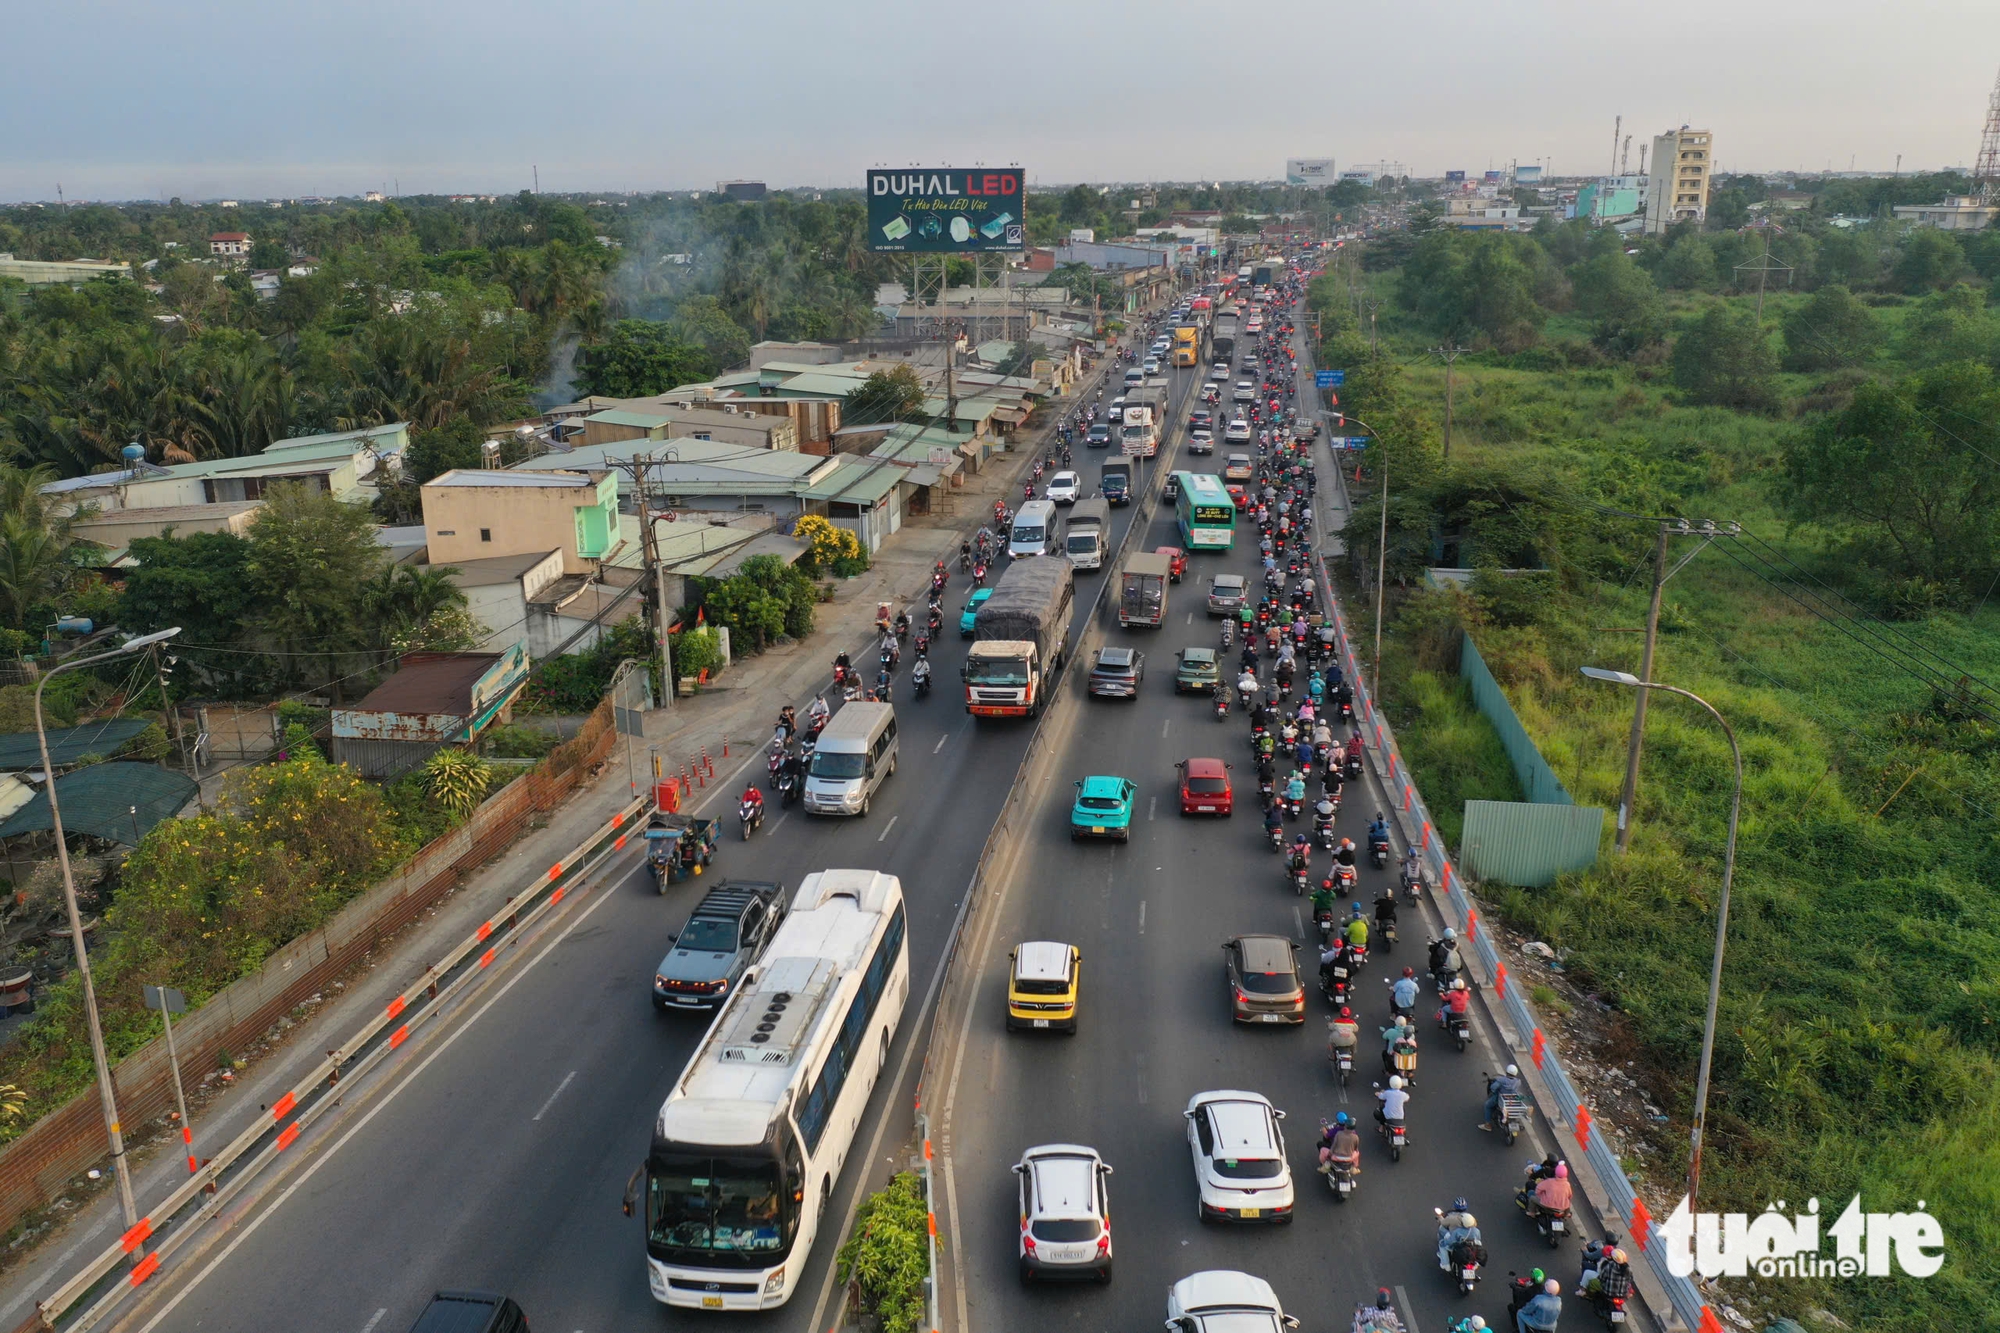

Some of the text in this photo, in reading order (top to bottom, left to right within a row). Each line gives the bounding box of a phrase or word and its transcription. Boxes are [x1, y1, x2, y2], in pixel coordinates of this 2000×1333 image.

[873, 174, 1017, 196] DUHAL LED
[902, 198, 988, 212] Tự Hào Đèn LED Việt
